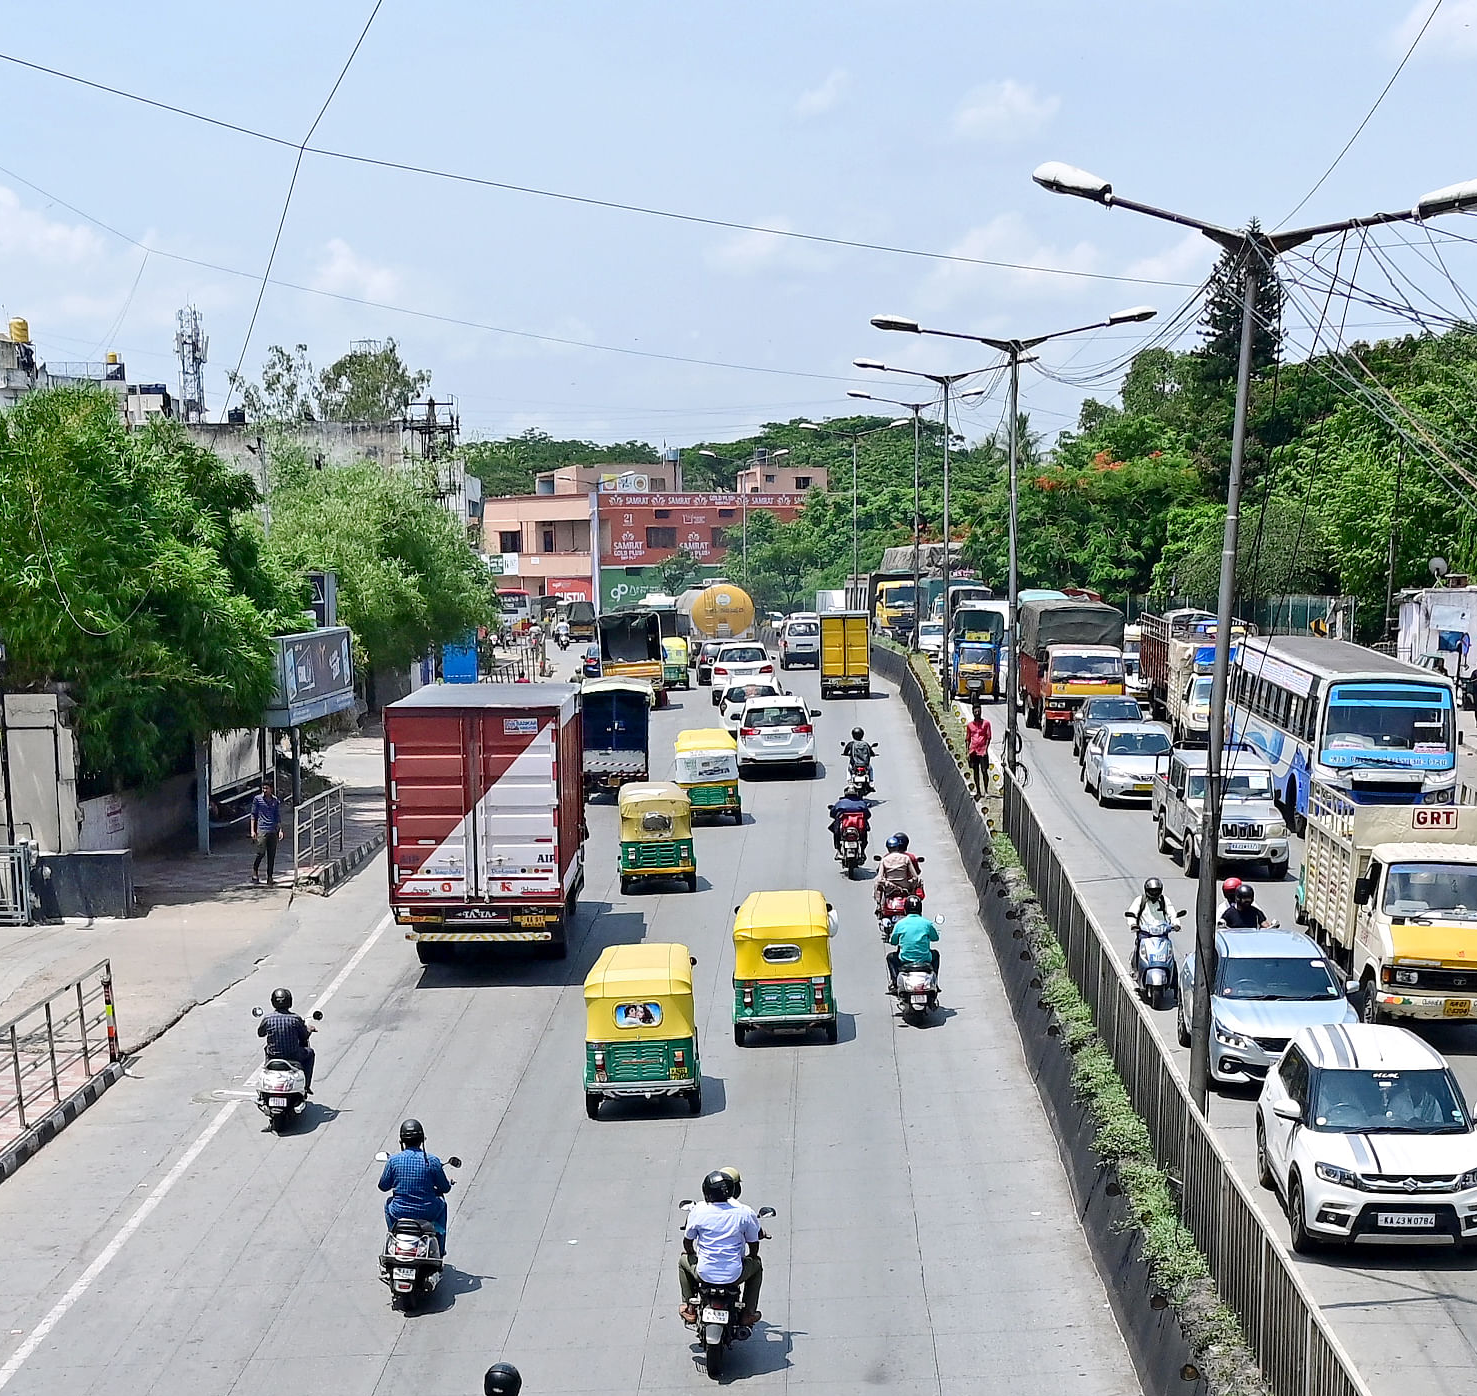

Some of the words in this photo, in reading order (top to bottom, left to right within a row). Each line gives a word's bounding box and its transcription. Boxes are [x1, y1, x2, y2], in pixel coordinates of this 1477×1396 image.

[613, 541, 644, 550] SAMRAT
[1416, 811, 1454, 825] GRT
[1383, 1216, 1394, 1225] KA
[1396, 1215, 1407, 1225] 43
[1413, 1216, 1435, 1226] 0784
